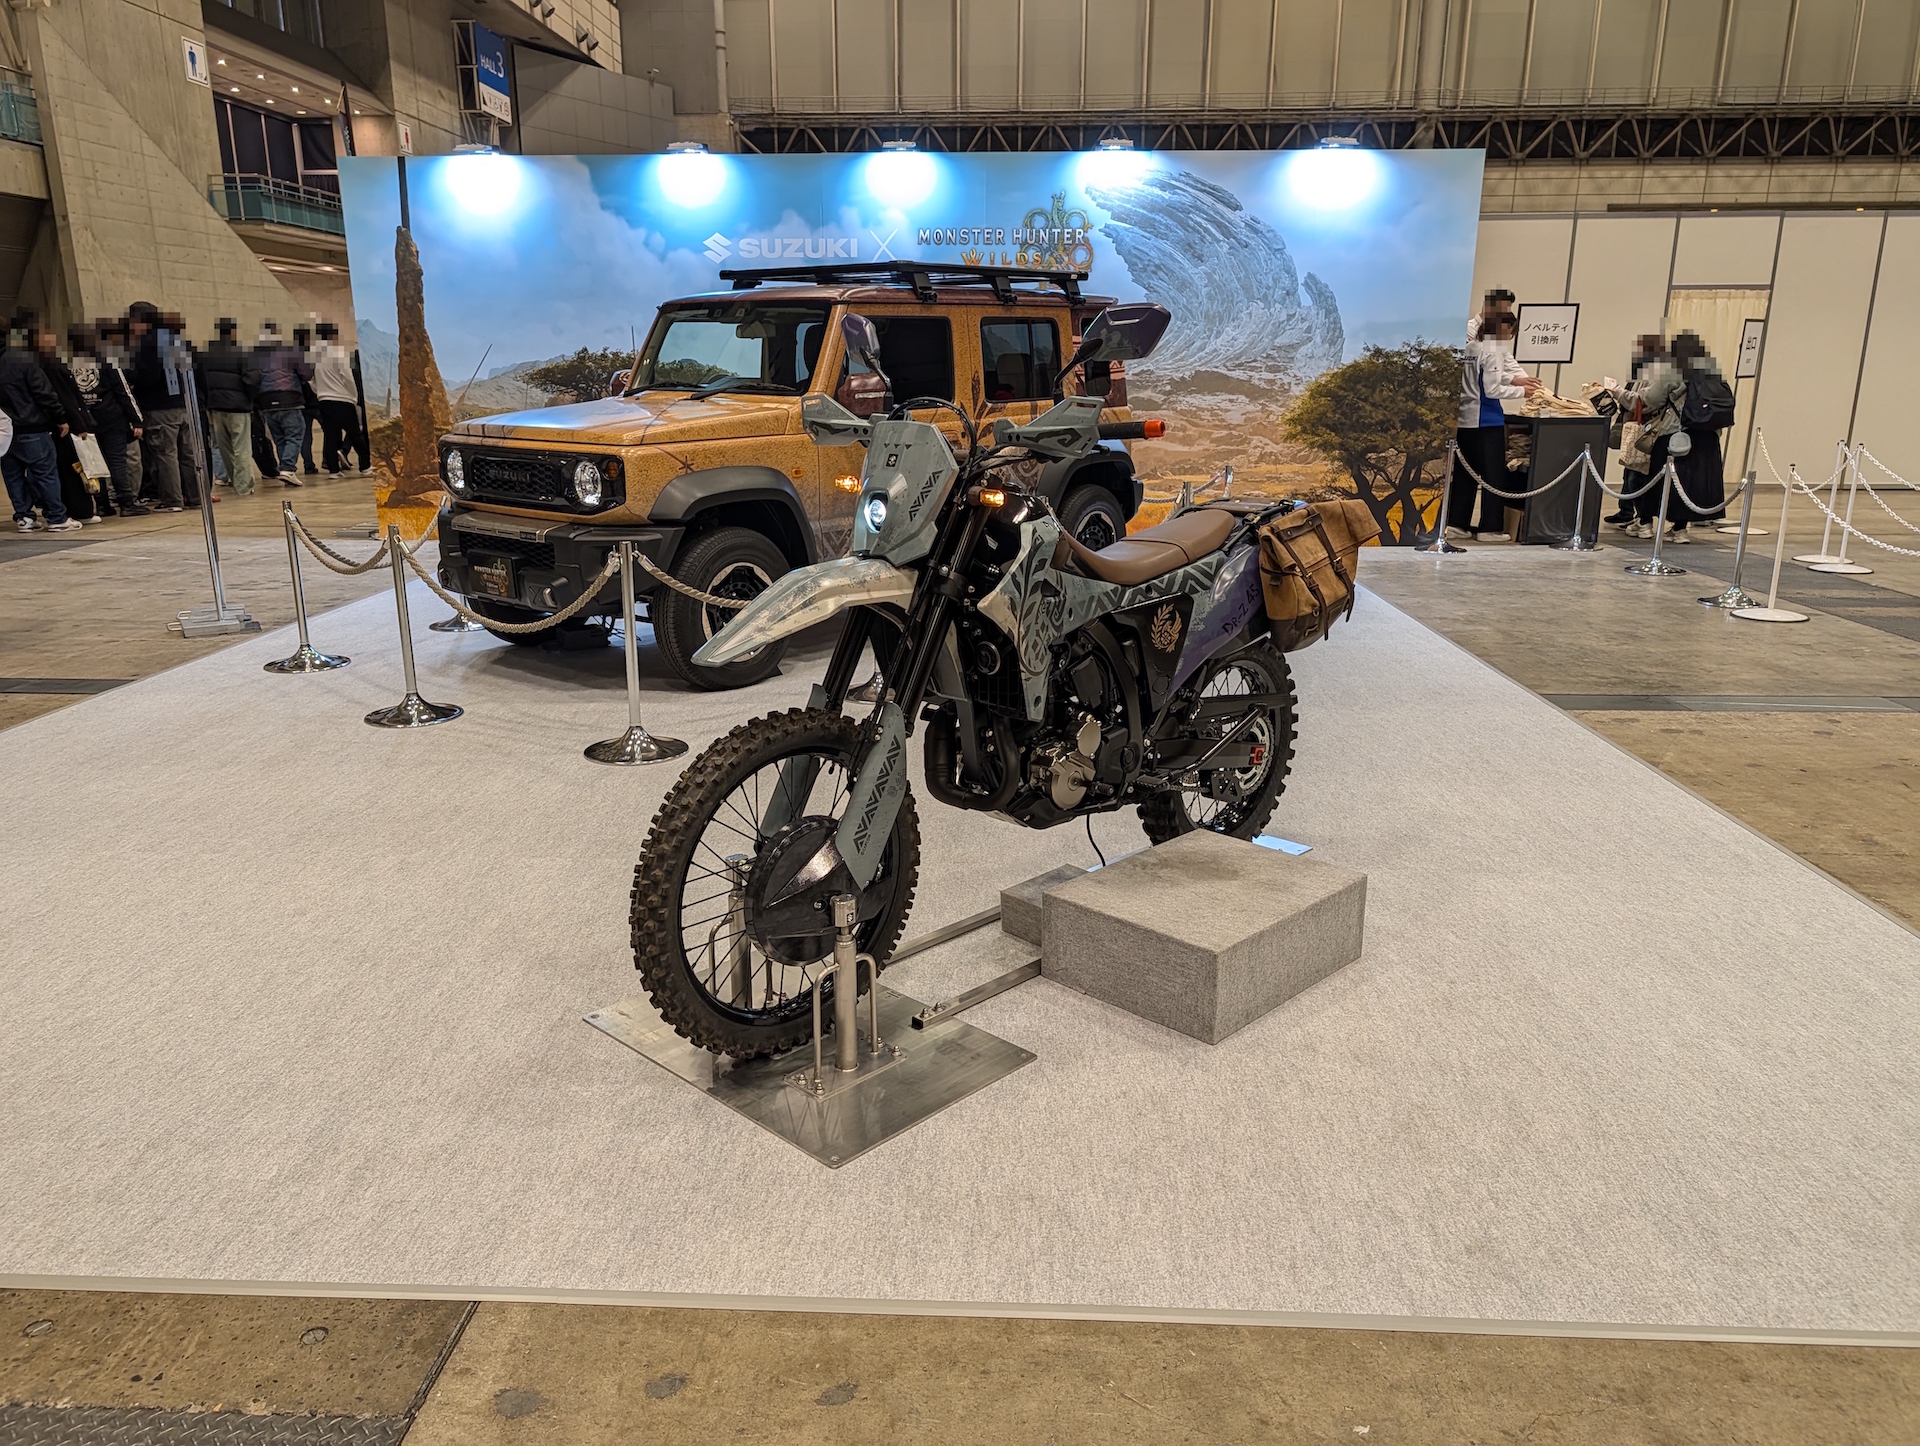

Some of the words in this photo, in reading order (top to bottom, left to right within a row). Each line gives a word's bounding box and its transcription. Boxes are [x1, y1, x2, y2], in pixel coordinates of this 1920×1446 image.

[480, 54, 498, 75] HALL
[496, 51, 505, 78] 3
[738, 237, 858, 259] SUZUKI
[918, 228, 1005, 246] MONSTER
[1012, 228, 1086, 245] HUNTER
[961, 248, 1043, 267] WILDS
[1523, 323, 1569, 332] ノベルティ
[1531, 335, 1559, 345] 引換所
[1746, 336, 1758, 351] 出口
[489, 469, 530, 482] SUZUKI
